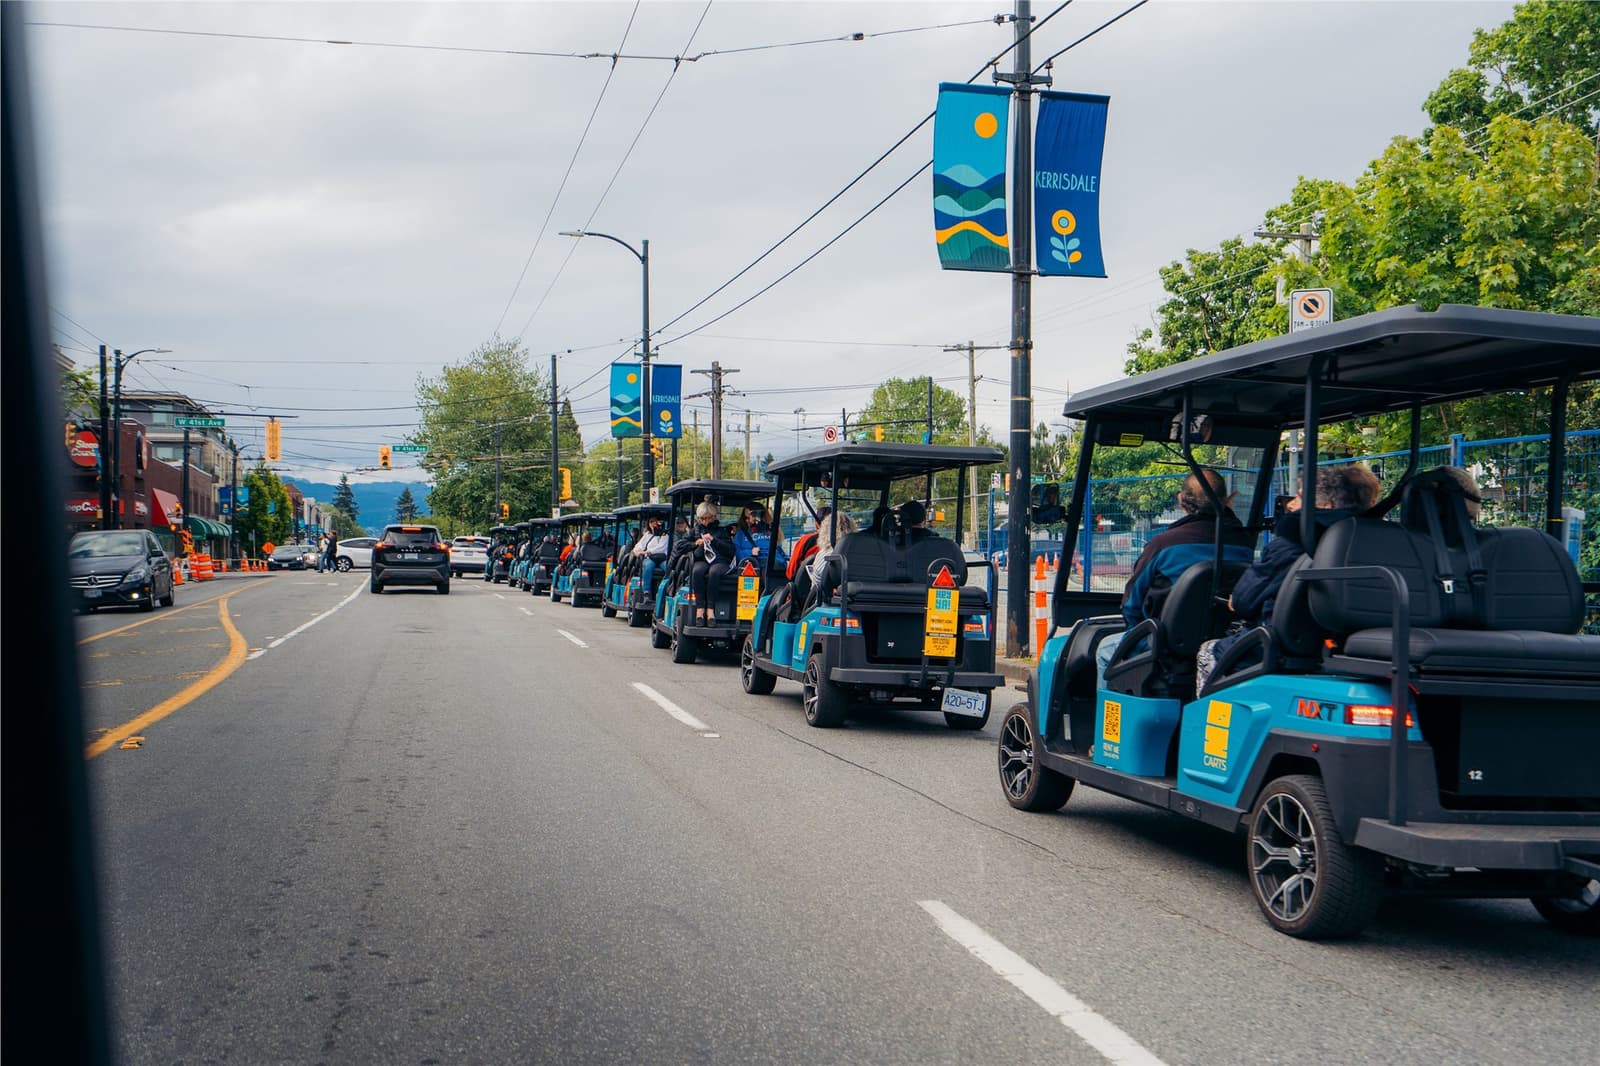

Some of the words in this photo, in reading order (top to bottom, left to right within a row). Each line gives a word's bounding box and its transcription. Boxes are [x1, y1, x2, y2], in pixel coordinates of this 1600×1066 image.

[1035, 170, 1097, 192] KERRISDALE
[1296, 698, 1338, 722] NXT
[1203, 755, 1228, 772] CARTS
[1467, 770, 1483, 781] 12
